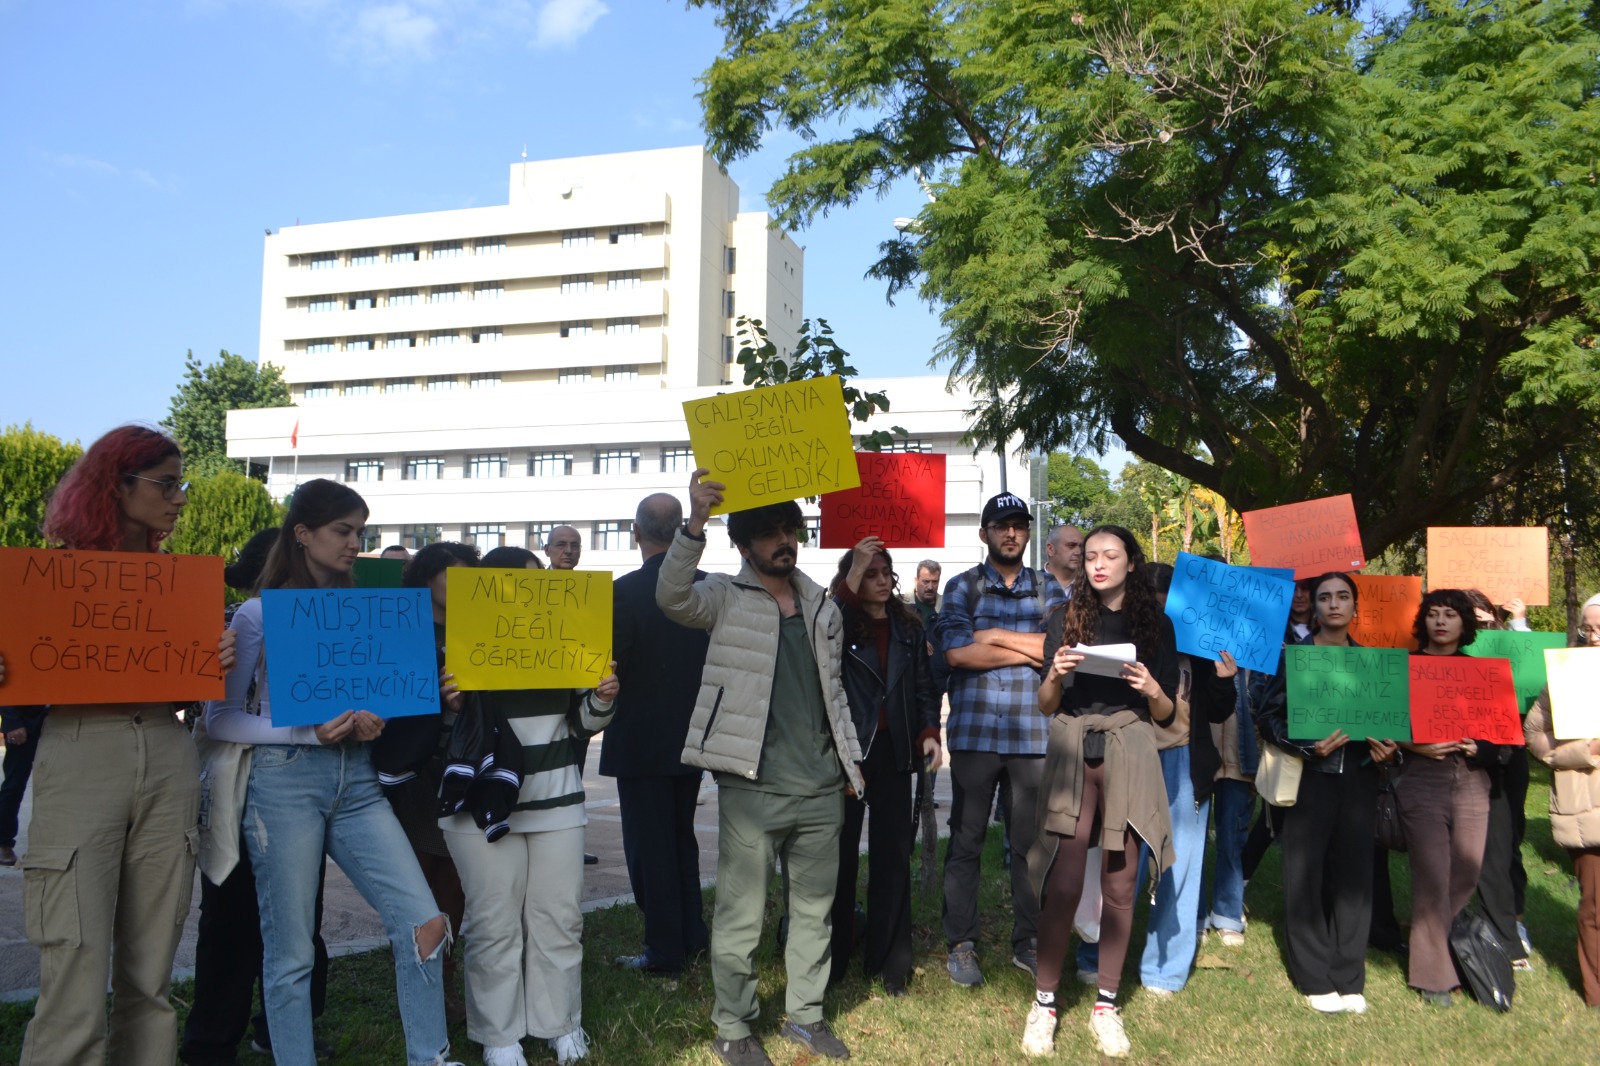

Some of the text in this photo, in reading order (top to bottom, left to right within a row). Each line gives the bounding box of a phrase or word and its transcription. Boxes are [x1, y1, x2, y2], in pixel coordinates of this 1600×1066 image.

[694, 385, 825, 428] ÇALIŞMAYA
[744, 415, 804, 440] DEĞİL
[713, 437, 830, 473] OKUMAYA
[857, 457, 934, 479] LIŞMAYA
[861, 479, 911, 500] DEĞİL
[837, 503, 920, 522] OKUMAYA
[1260, 504, 1344, 531] BESLENME
[1280, 519, 1349, 548] HAKKIMIZ
[1447, 557, 1523, 574] DENGELİ
[1467, 549, 1489, 560] VE
[22, 553, 178, 598] MÜŞTERİ
[1185, 559, 1284, 605] ÇALIŞMAYA
[1441, 575, 1546, 591] BESLENMEK
[471, 572, 593, 609] MÜŞTERİ
[1357, 583, 1408, 603] AMLAR
[71, 598, 168, 633] DEĞİL
[291, 592, 421, 632] MÜŞTERİ
[1206, 591, 1259, 622] DEĞİL
[494, 610, 577, 642] DEĞİL
[1181, 606, 1268, 646] OKUMAYA
[317, 634, 398, 668] DEĞİL
[1294, 648, 1401, 677] BESLENME
[291, 669, 436, 703] ÖĞRENCİYİZ!
[1475, 666, 1502, 683] VE
[1309, 680, 1392, 699] HAKKIMIZ
[1436, 684, 1494, 701] DENGELİ
[1292, 707, 1409, 728] ENGELLENEMEZ
[1433, 704, 1513, 722] BESLENMEK
